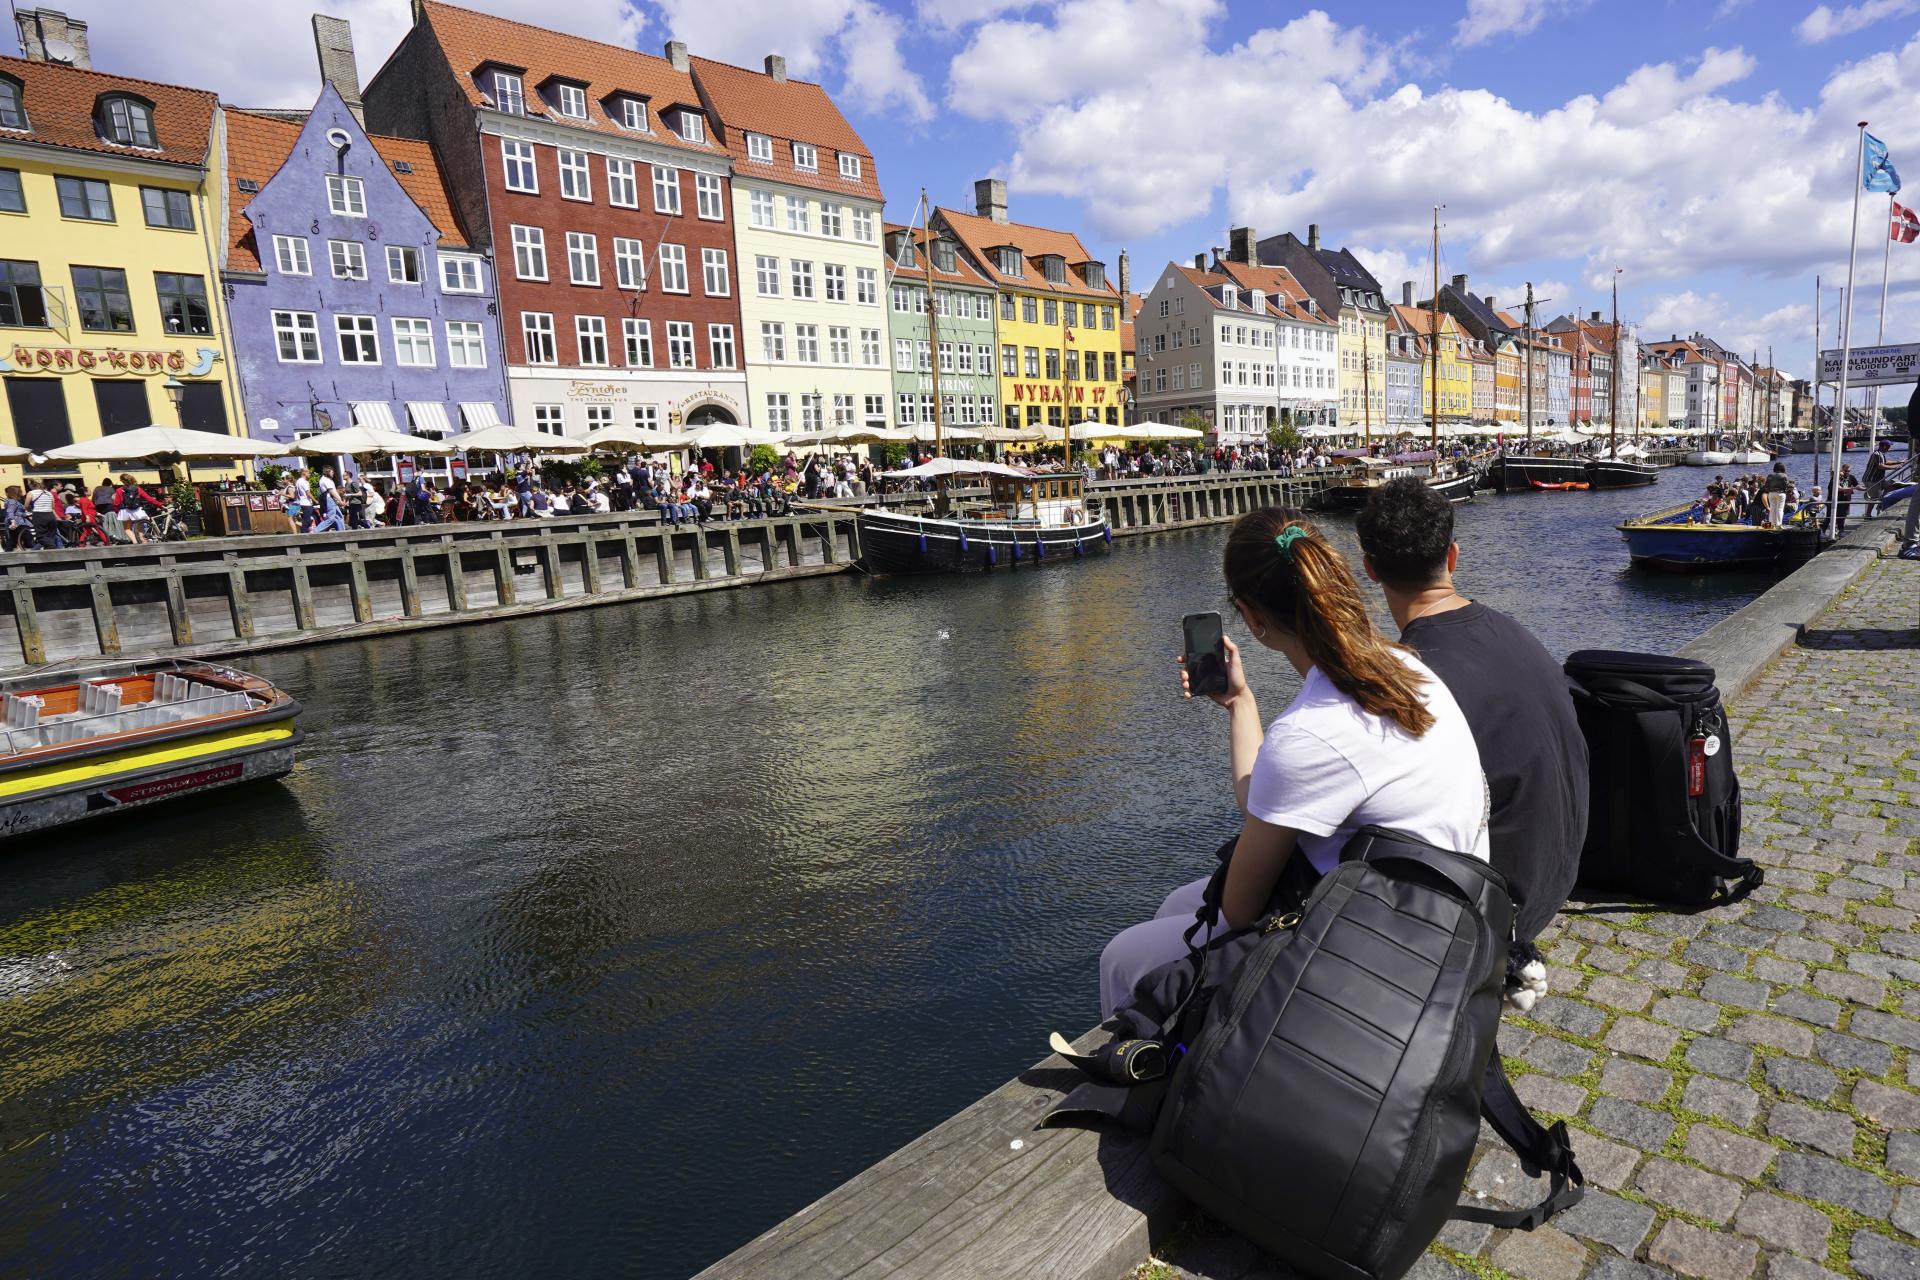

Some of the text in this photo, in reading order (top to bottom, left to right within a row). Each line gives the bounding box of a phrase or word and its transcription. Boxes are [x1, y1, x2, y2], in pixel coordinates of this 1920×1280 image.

[15, 348, 185, 371] HONG-KONG
[1855, 362, 1888, 371] GUIDED
[1892, 360, 1916, 368] TOUR
[685, 390, 735, 405] RESTAURANT
[1092, 387, 1106, 404] 17
